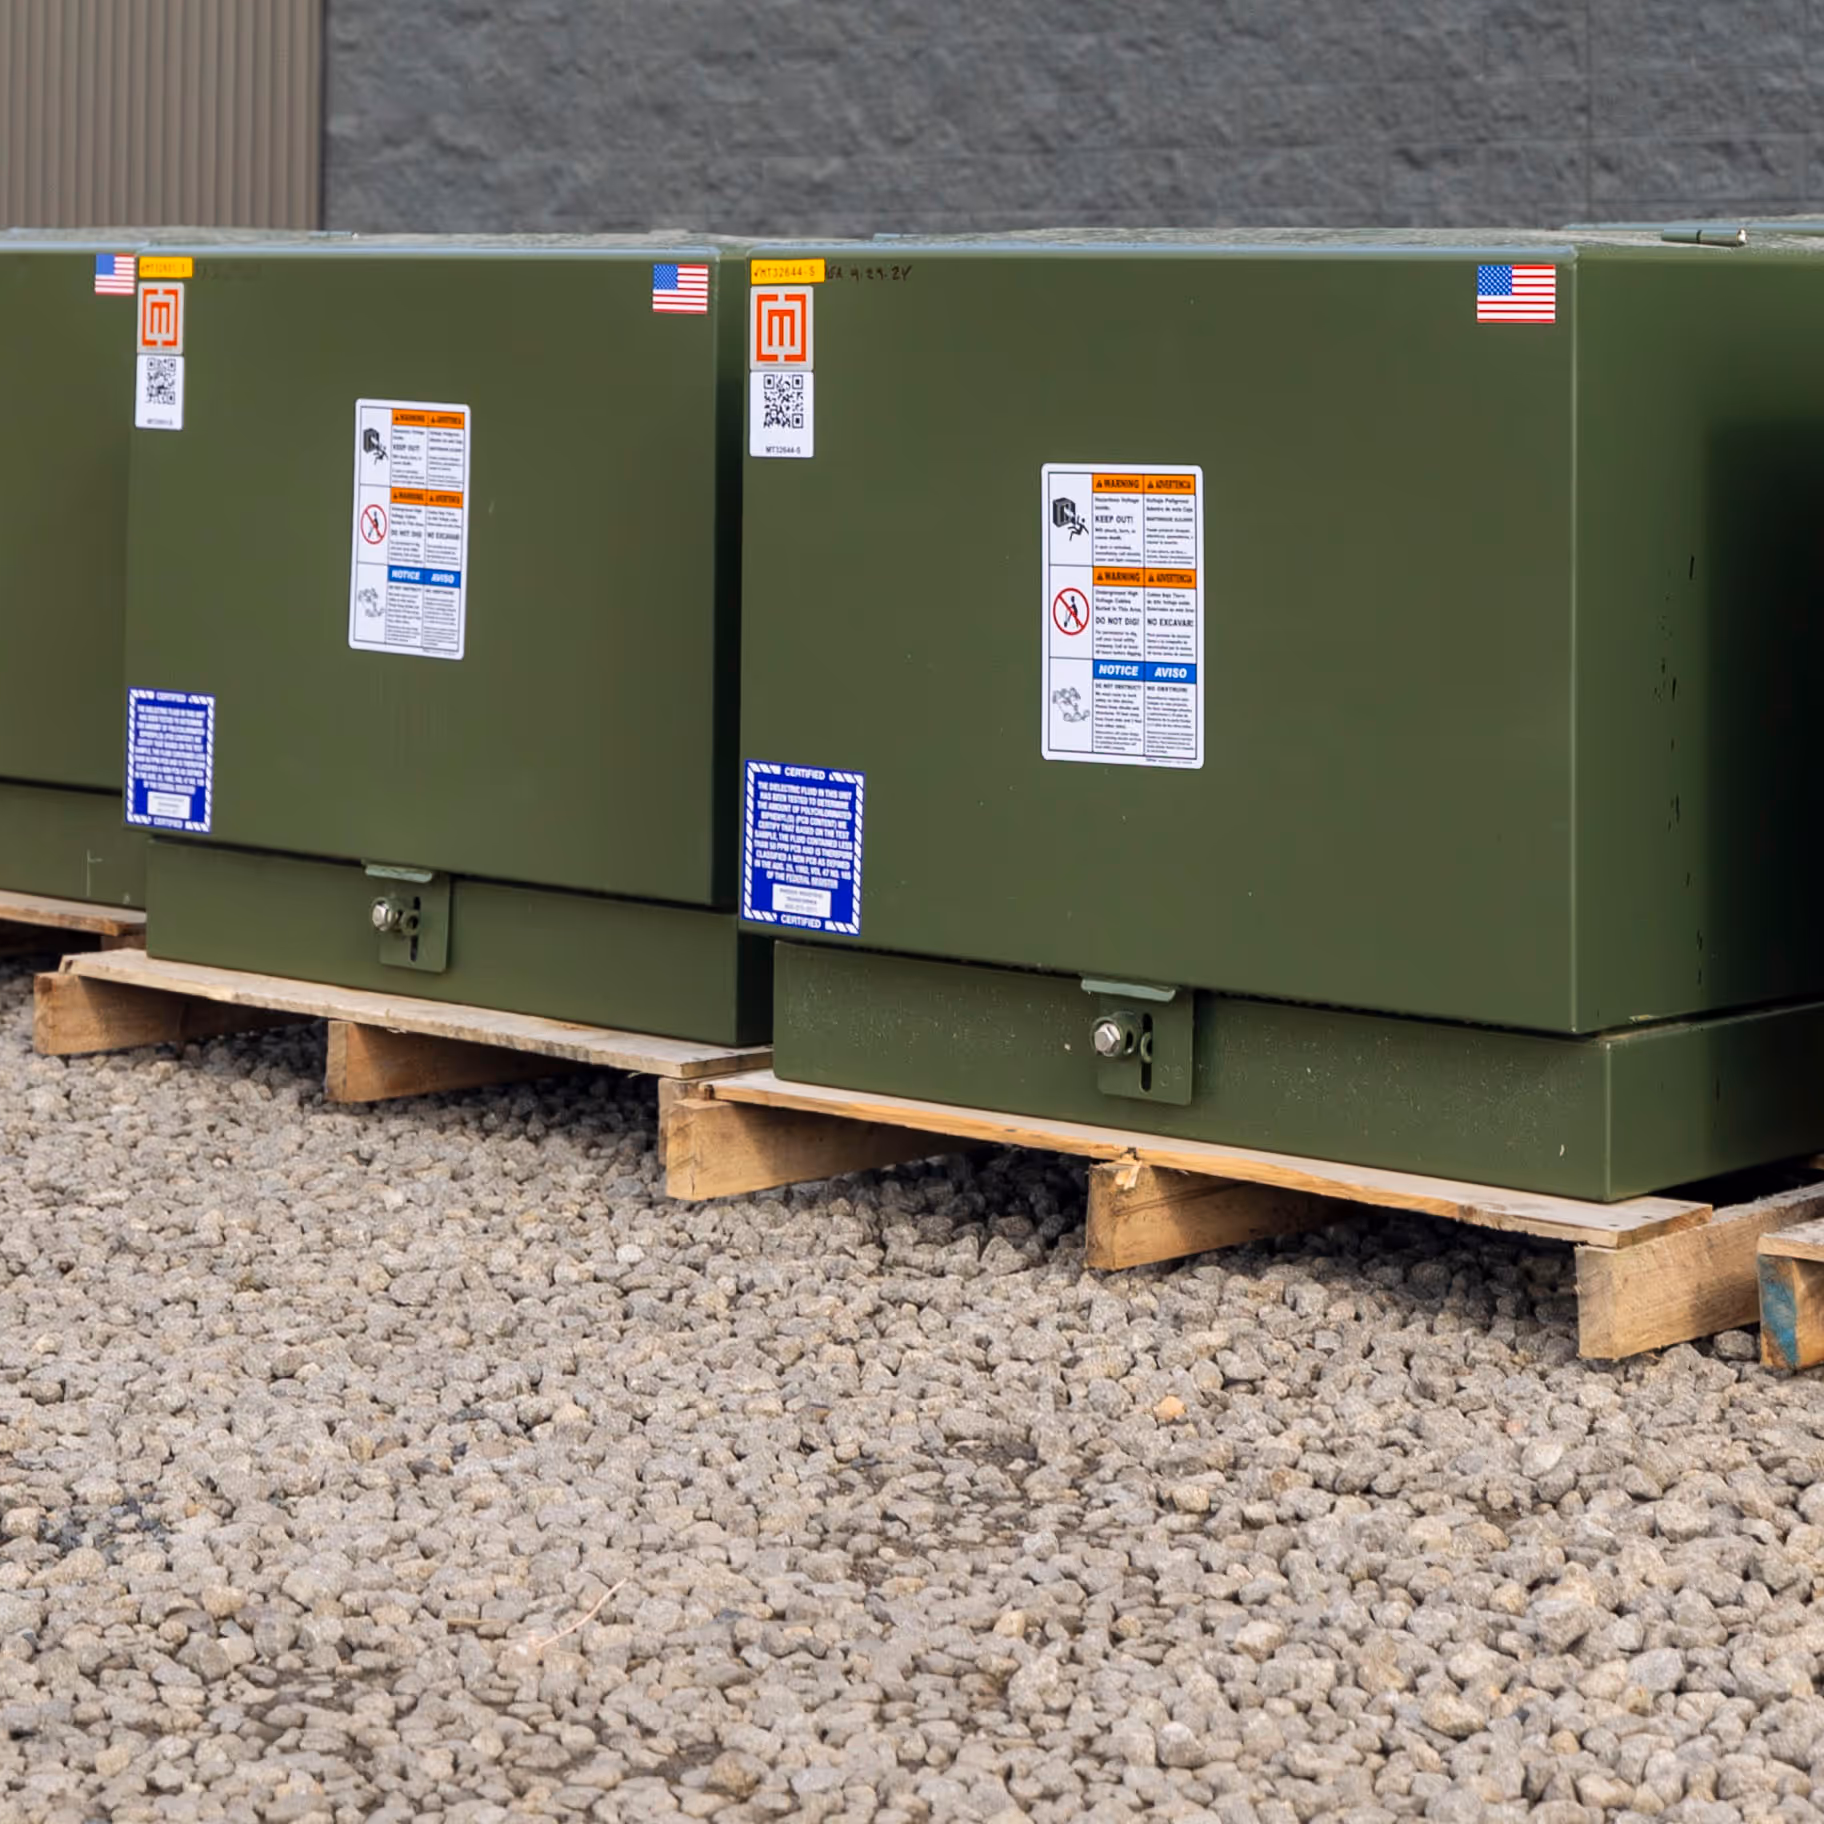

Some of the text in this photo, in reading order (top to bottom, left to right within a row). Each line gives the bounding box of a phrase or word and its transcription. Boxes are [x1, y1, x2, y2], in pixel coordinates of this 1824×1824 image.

[1104, 479, 1139, 488] WARNING
[1095, 515, 1133, 524] KEEP OUT!
[1104, 571, 1140, 582] WARNING
[1095, 616, 1140, 626] DO NOT DIG!
[1147, 618, 1193, 627] NO EXCAVAR!
[1098, 664, 1139, 676] NOTICE
[1154, 667, 1187, 679] AVISO
[784, 766, 826, 780] CERTIFIED
[780, 914, 822, 929] CERTIFIED
